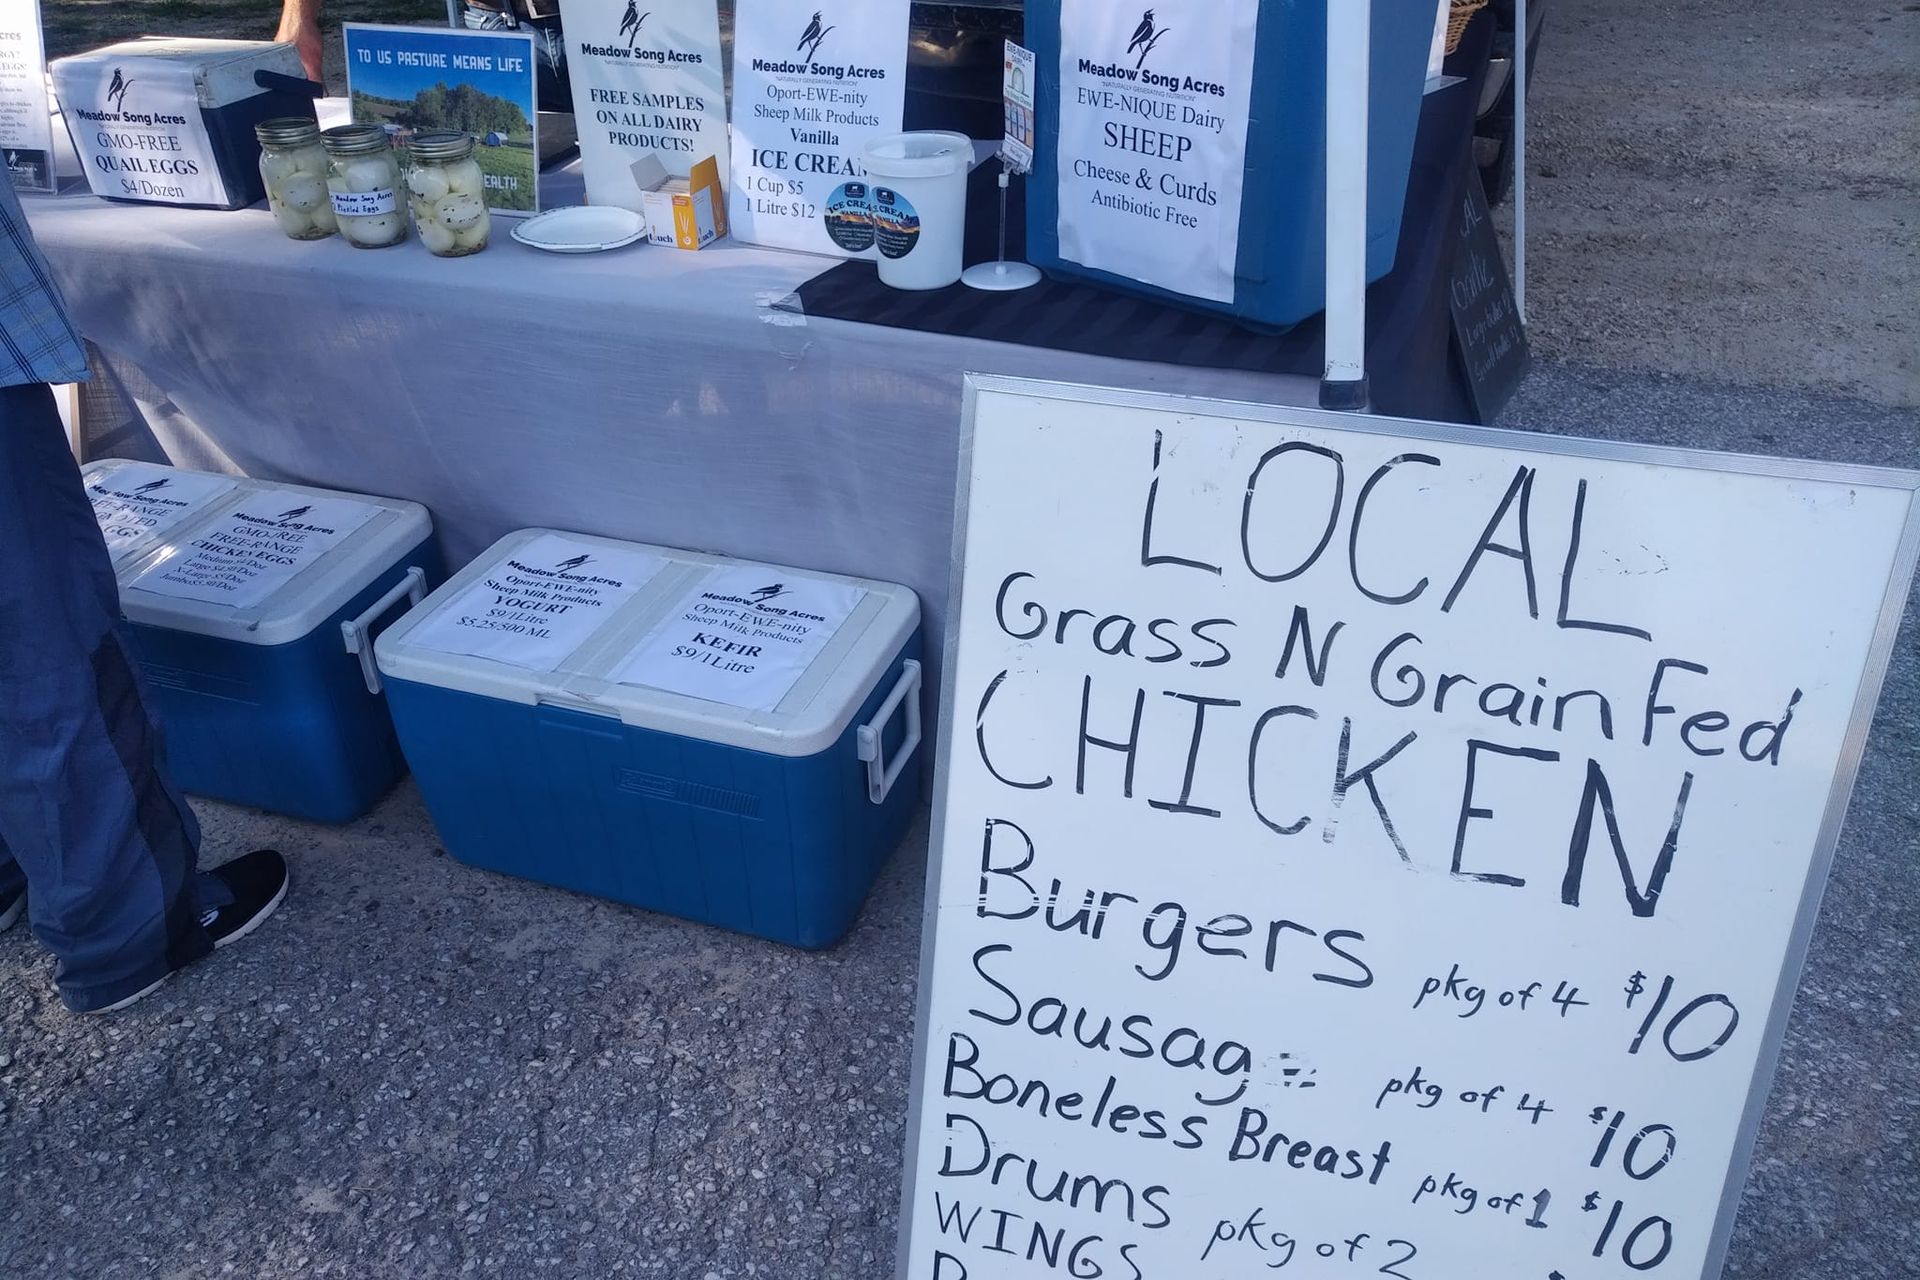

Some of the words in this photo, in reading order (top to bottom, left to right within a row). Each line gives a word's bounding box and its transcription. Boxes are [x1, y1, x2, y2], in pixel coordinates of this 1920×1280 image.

[357, 48, 372, 63] TO
[377, 50, 392, 64] US
[397, 51, 448, 69] PASTURE
[453, 54, 492, 71] MEANS
[497, 57, 523, 73] LIFE
[581, 43, 631, 58] Meadow
[634, 47, 665, 64] Song
[667, 49, 703, 64] Acres
[751, 58, 808, 75] Meadow
[810, 62, 844, 80] Song
[847, 65, 885, 79] Acres
[1077, 58, 1138, 82] Meadow
[1141, 69, 1180, 92] Song
[1182, 75, 1226, 97] Acres
[590, 88, 630, 105] FREE
[632, 91, 705, 112] SAMPLES
[766, 84, 868, 106] Oport-EWE-nity
[76, 109, 120, 122] Meadow
[122, 111, 152, 127] Song
[154, 112, 186, 125] Acres
[596, 109, 618, 125] ON
[621, 112, 652, 128] ALL
[653, 114, 703, 132] DAIRY
[753, 104, 790, 123] Sheep
[793, 105, 822, 123] Milk
[825, 108, 880, 127] Products
[1077, 87, 1177, 121] EWE-NIQUE
[1182, 106, 1225, 135] Dairy
[97, 132, 182, 152] GMO-FREE
[609, 131, 695, 153] PRODUCTS!
[790, 127, 840, 146] Vanilla
[1104, 121, 1193, 163] SHEEP
[96, 154, 149, 174] QUAIL
[149, 158, 199, 176] EGGS
[751, 148, 789, 171] ICE
[120, 178, 185, 198] $4/Dozen
[483, 173, 518, 190] EALTH
[747, 175, 752, 190] 1
[757, 176, 784, 197] Cup
[787, 180, 804, 195] $5
[1073, 159, 1131, 186] Cheese
[1135, 167, 1153, 191] &
[1159, 173, 1218, 206] Curds
[746, 196, 751, 212] 1
[757, 198, 788, 216] Litre
[791, 201, 815, 219] $12
[828, 200, 846, 214] ICE
[1090, 188, 1161, 220] Antibiotic
[1165, 206, 1198, 229] Free
[159, 498, 189, 507] Acres
[103, 524, 145, 538] GGS
[232, 512, 277, 528] Meadow
[304, 523, 336, 535] Acres
[1140, 428, 1653, 643] LOCAL
[209, 531, 304, 556] FREE-RANGE
[255, 551, 297, 566] EGGS
[505, 574, 601, 597] Oport-EWE-nity
[507, 559, 557, 578] Meadow
[557, 571, 589, 583] Song
[588, 575, 623, 589] Acres
[483, 578, 520, 597] Sheep
[520, 586, 549, 600] Milk
[552, 592, 604, 608] Products
[492, 594, 574, 616] YOGURT
[486, 607, 549, 625] $9/1Litre
[693, 602, 813, 635] Oport-EWE-nity
[700, 591, 753, 606] Meadow
[755, 602, 788, 616] Song
[788, 610, 826, 623] Acres
[456, 614, 526, 635] $5.25/500
[525, 626, 551, 640] ML
[682, 612, 718, 627] Sheep
[720, 619, 750, 636] Milk
[749, 627, 804, 645] Products
[691, 631, 763, 659] KEFIR
[671, 644, 756, 675] $9/1Litre
[995, 571, 1239, 668] Grass
[1275, 604, 1348, 687] N
[1370, 631, 1613, 740] Grain
[1641, 657, 1804, 767] Fed
[975, 669, 1694, 918] CHICKEN
[976, 817, 1375, 989] Burgers
[1412, 963, 1487, 1019] pkg
[1498, 981, 1543, 1010] of
[1551, 980, 1590, 1018] 4
[1623, 969, 1740, 1063] $10
[1375, 1065, 1444, 1109] pkg
[1458, 1085, 1505, 1113] of
[1516, 1092, 1555, 1125] 4
[1588, 1105, 1678, 1181] $10
[942, 1031, 1209, 1150] Boneless
[1228, 1106, 1391, 1186] Breast
[1411, 1171, 1478, 1215] pkg
[1486, 1191, 1524, 1215] of
[1524, 1187, 1552, 1229] 1
[1580, 1190, 1674, 1271] $10
[937, 1112, 1172, 1230] Drums
[1199, 1206, 1297, 1269] pkg
[1315, 1232, 1371, 1262] of
[1378, 1239, 1418, 1280] 2
[934, 1190, 1143, 1280] WINGS
